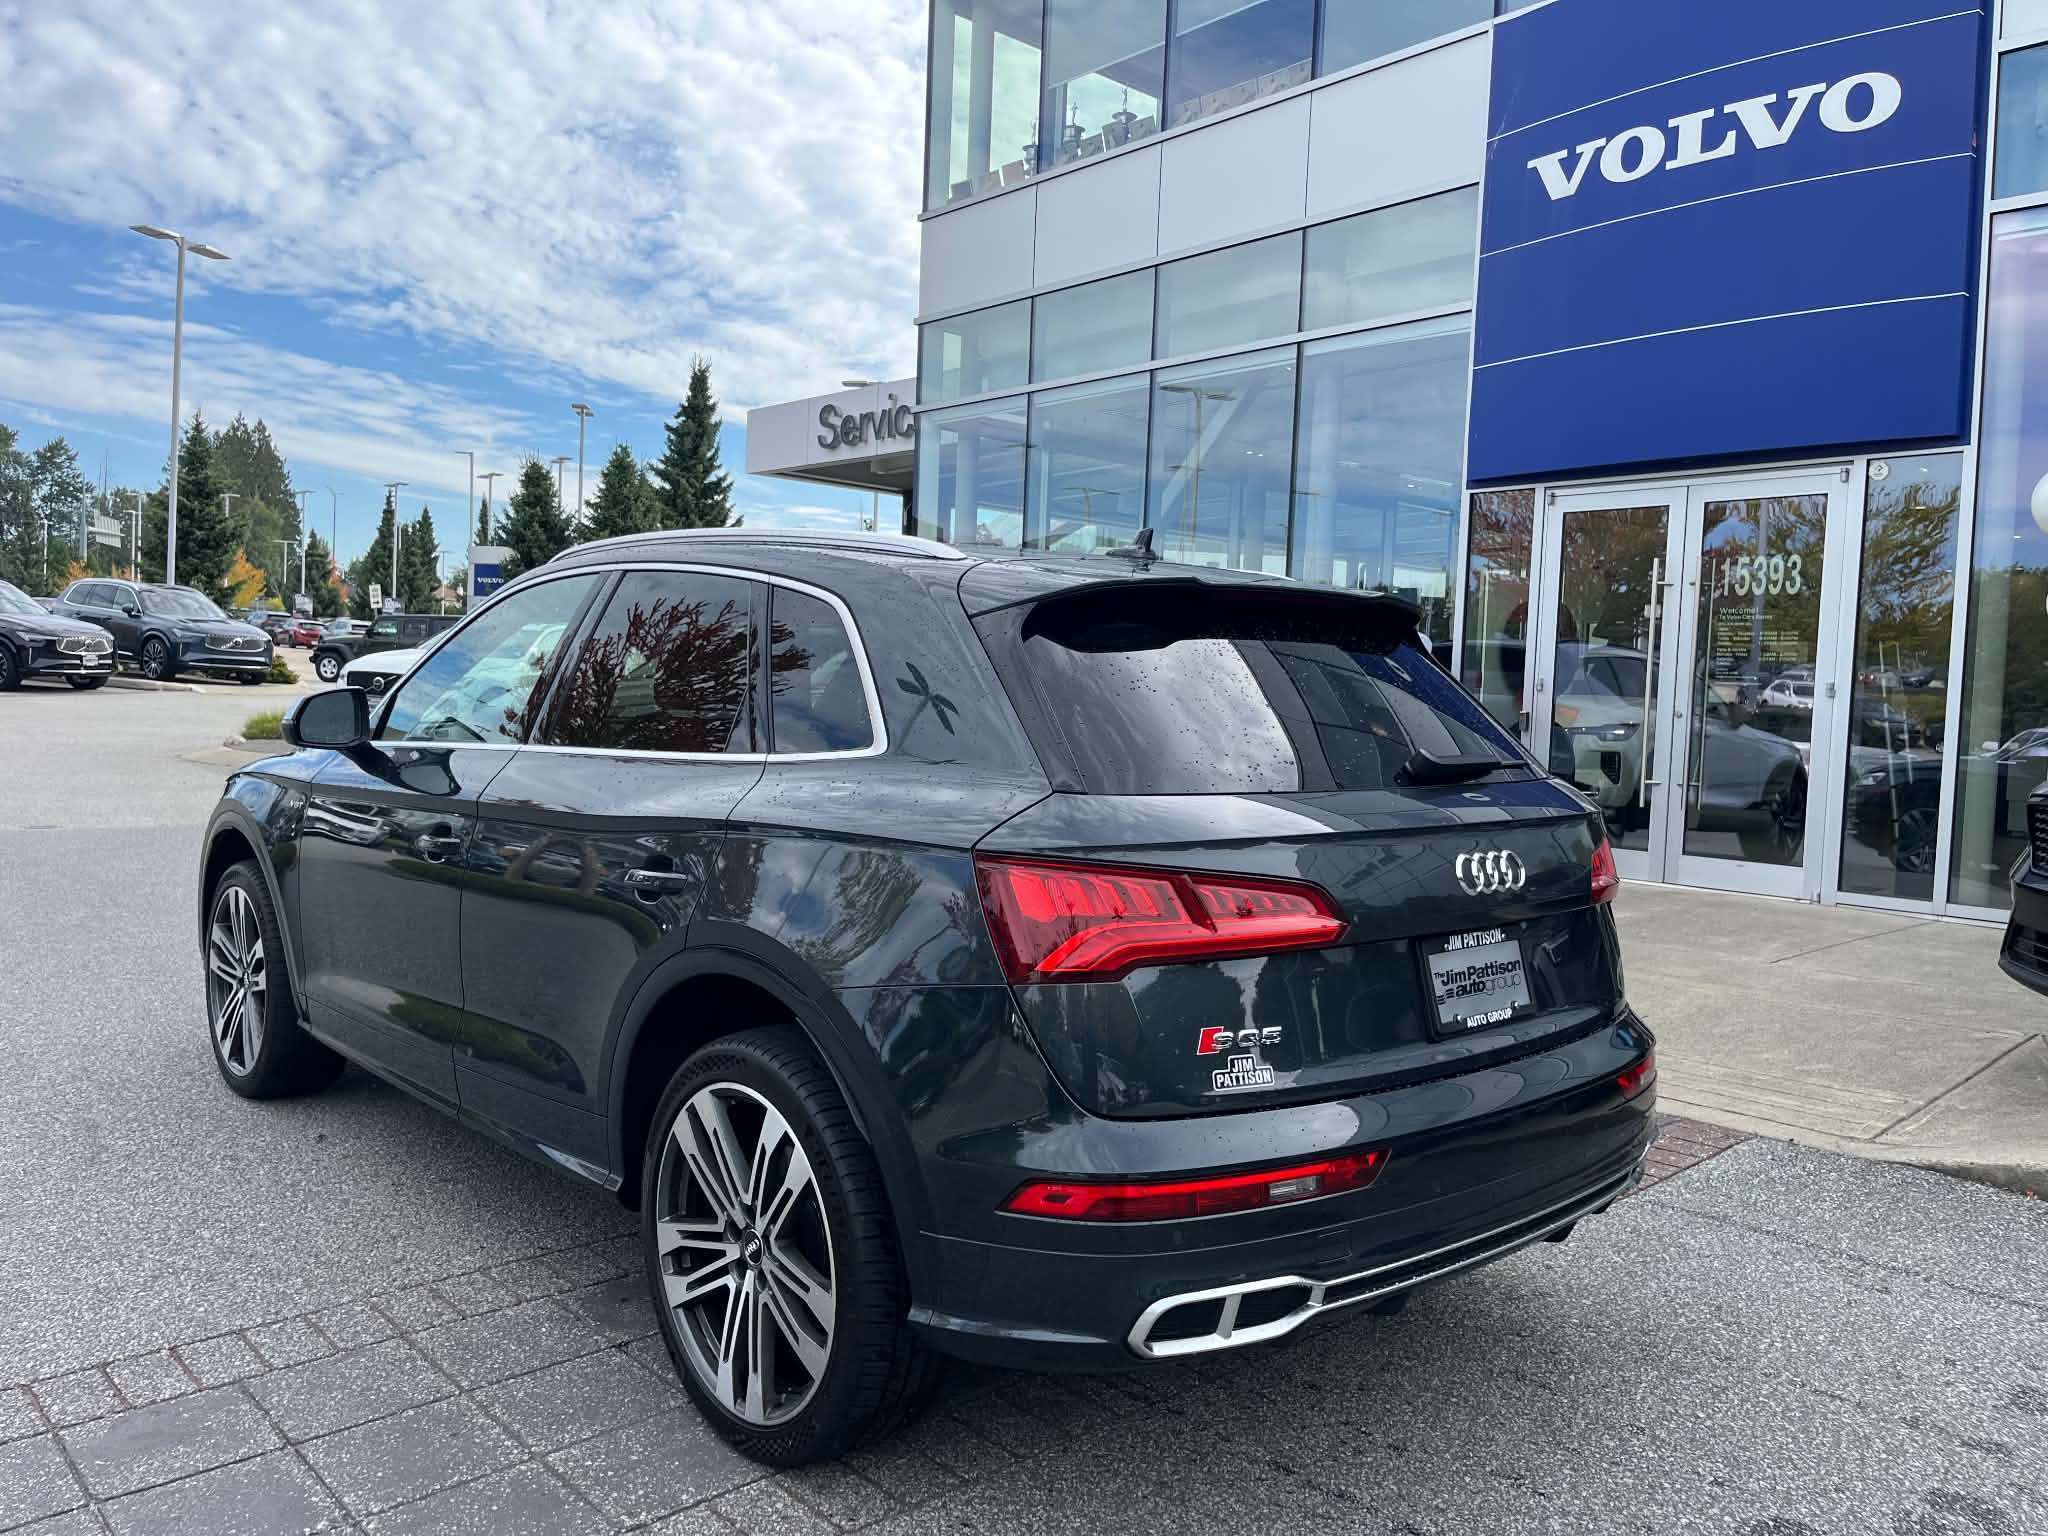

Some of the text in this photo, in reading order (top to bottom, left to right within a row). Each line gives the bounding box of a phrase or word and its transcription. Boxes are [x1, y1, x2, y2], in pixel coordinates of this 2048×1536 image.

[1527, 72, 1902, 200] VOLVO
[817, 393, 916, 449] Servic
[1722, 554, 1801, 596] 15393
[1447, 928, 1502, 951] JIM PATTISON
[1466, 1007, 1513, 1028] AUTO GROUP
[1211, 1026, 1282, 1050] SQ5
[1231, 1058, 1254, 1073] JIM
[1215, 1069, 1272, 1088] PATTISON
